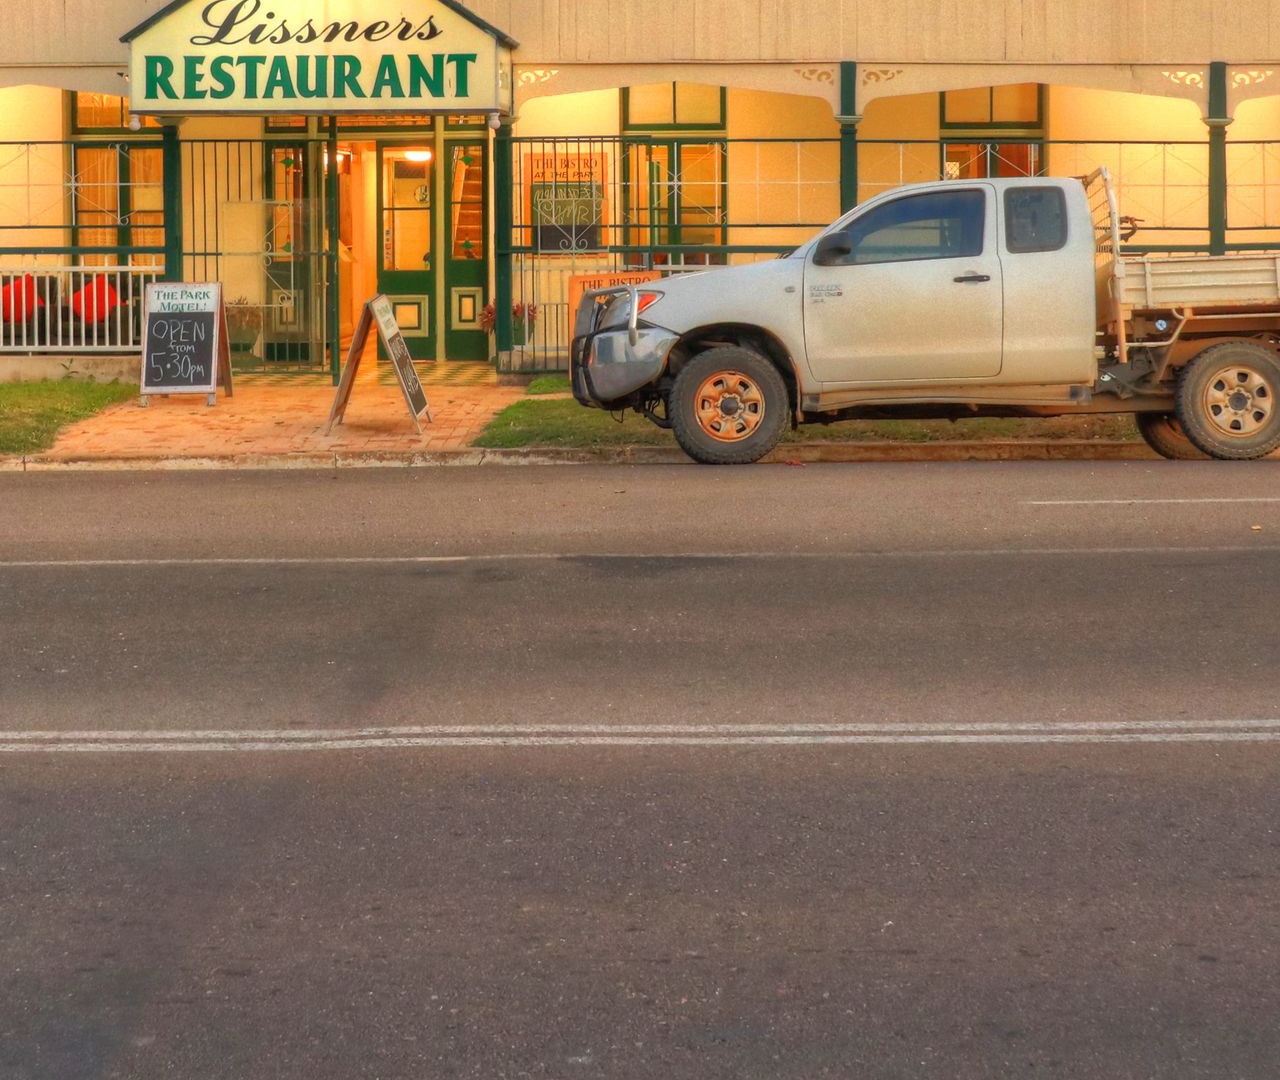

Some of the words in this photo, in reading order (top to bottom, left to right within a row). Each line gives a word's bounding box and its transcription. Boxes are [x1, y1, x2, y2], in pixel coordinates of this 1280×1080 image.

[144, 53, 477, 100] RESTAURANT
[580, 280, 603, 290] THE
[154, 289, 178, 301] THE
[180, 289, 210, 301] PARK
[152, 319, 205, 342] OPEN
